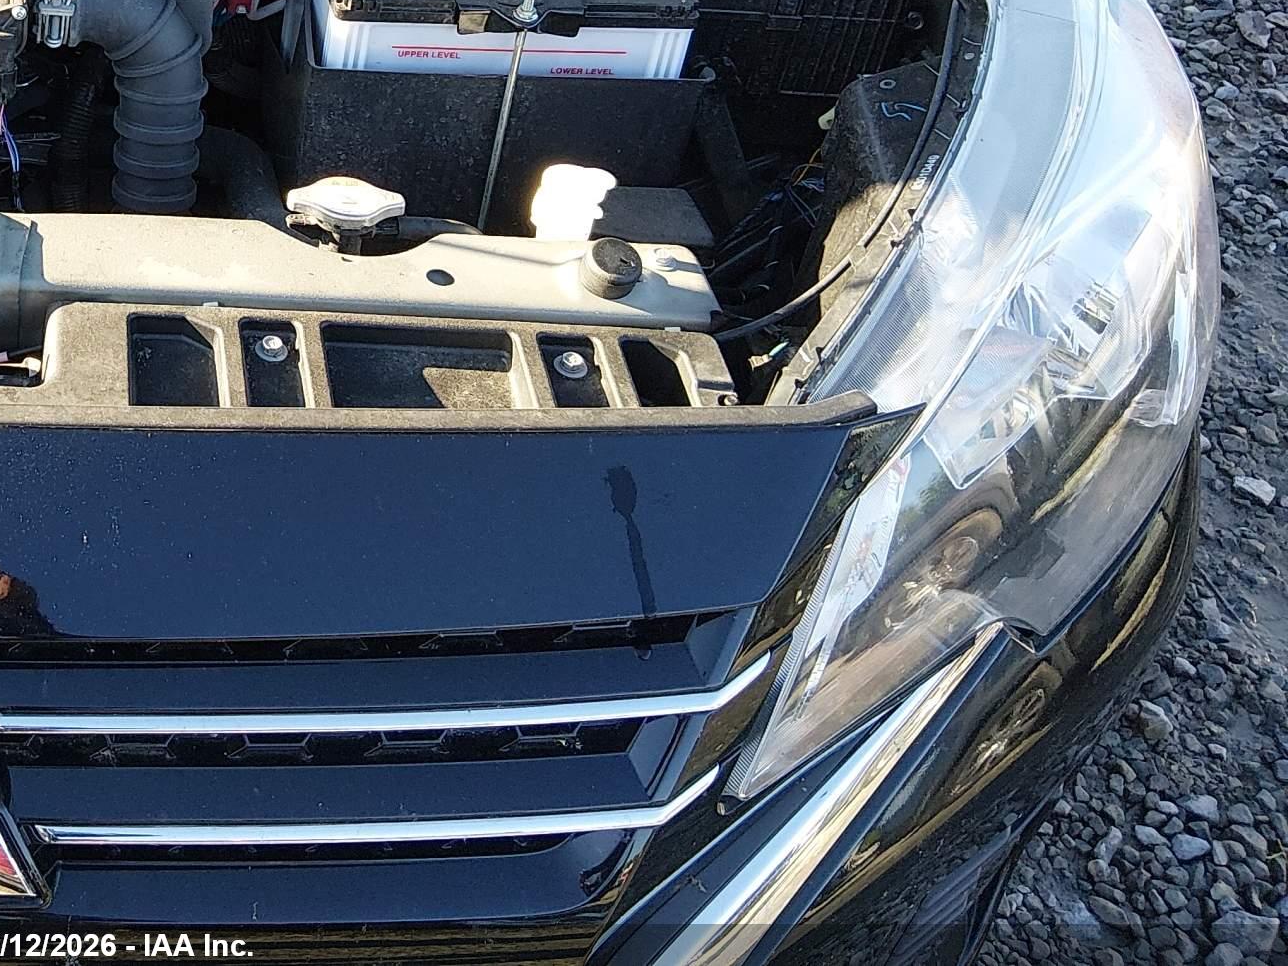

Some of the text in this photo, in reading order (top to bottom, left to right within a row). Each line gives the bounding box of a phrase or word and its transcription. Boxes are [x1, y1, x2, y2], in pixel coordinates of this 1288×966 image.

[397, 50, 461, 59] UPPER LEVEL
[550, 67, 614, 75] LOWER LEVEL
